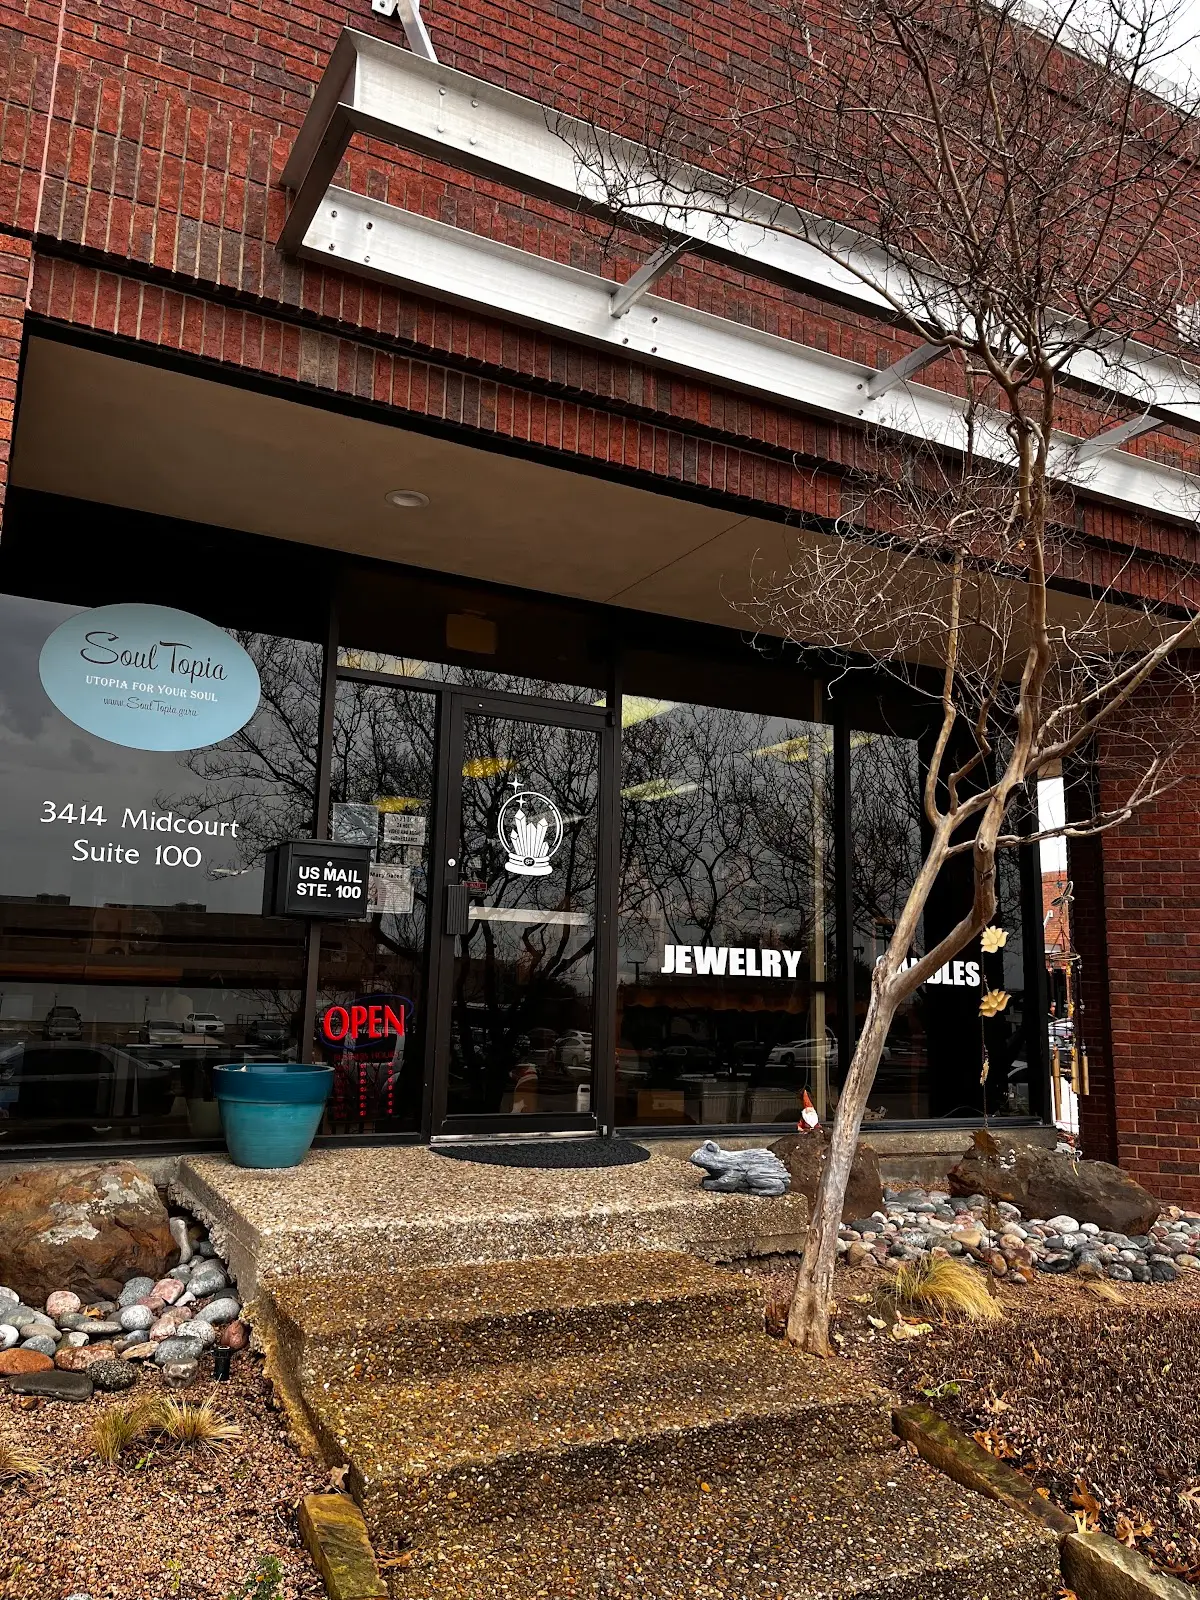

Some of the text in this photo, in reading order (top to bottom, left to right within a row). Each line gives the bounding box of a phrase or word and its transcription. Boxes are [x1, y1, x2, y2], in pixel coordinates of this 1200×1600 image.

[80, 631, 228, 683] Soul Topia
[86, 675, 218, 702] UTOPIA FOR YOUR SOUL
[40, 800, 239, 838] 3414 Midcourt
[72, 839, 202, 868] Suite 100
[299, 866, 362, 883] US MAIL
[296, 883, 331, 898] STE.
[335, 885, 361, 899] 100
[661, 944, 801, 978] JEWELRY
[324, 1004, 405, 1041] OPEN
